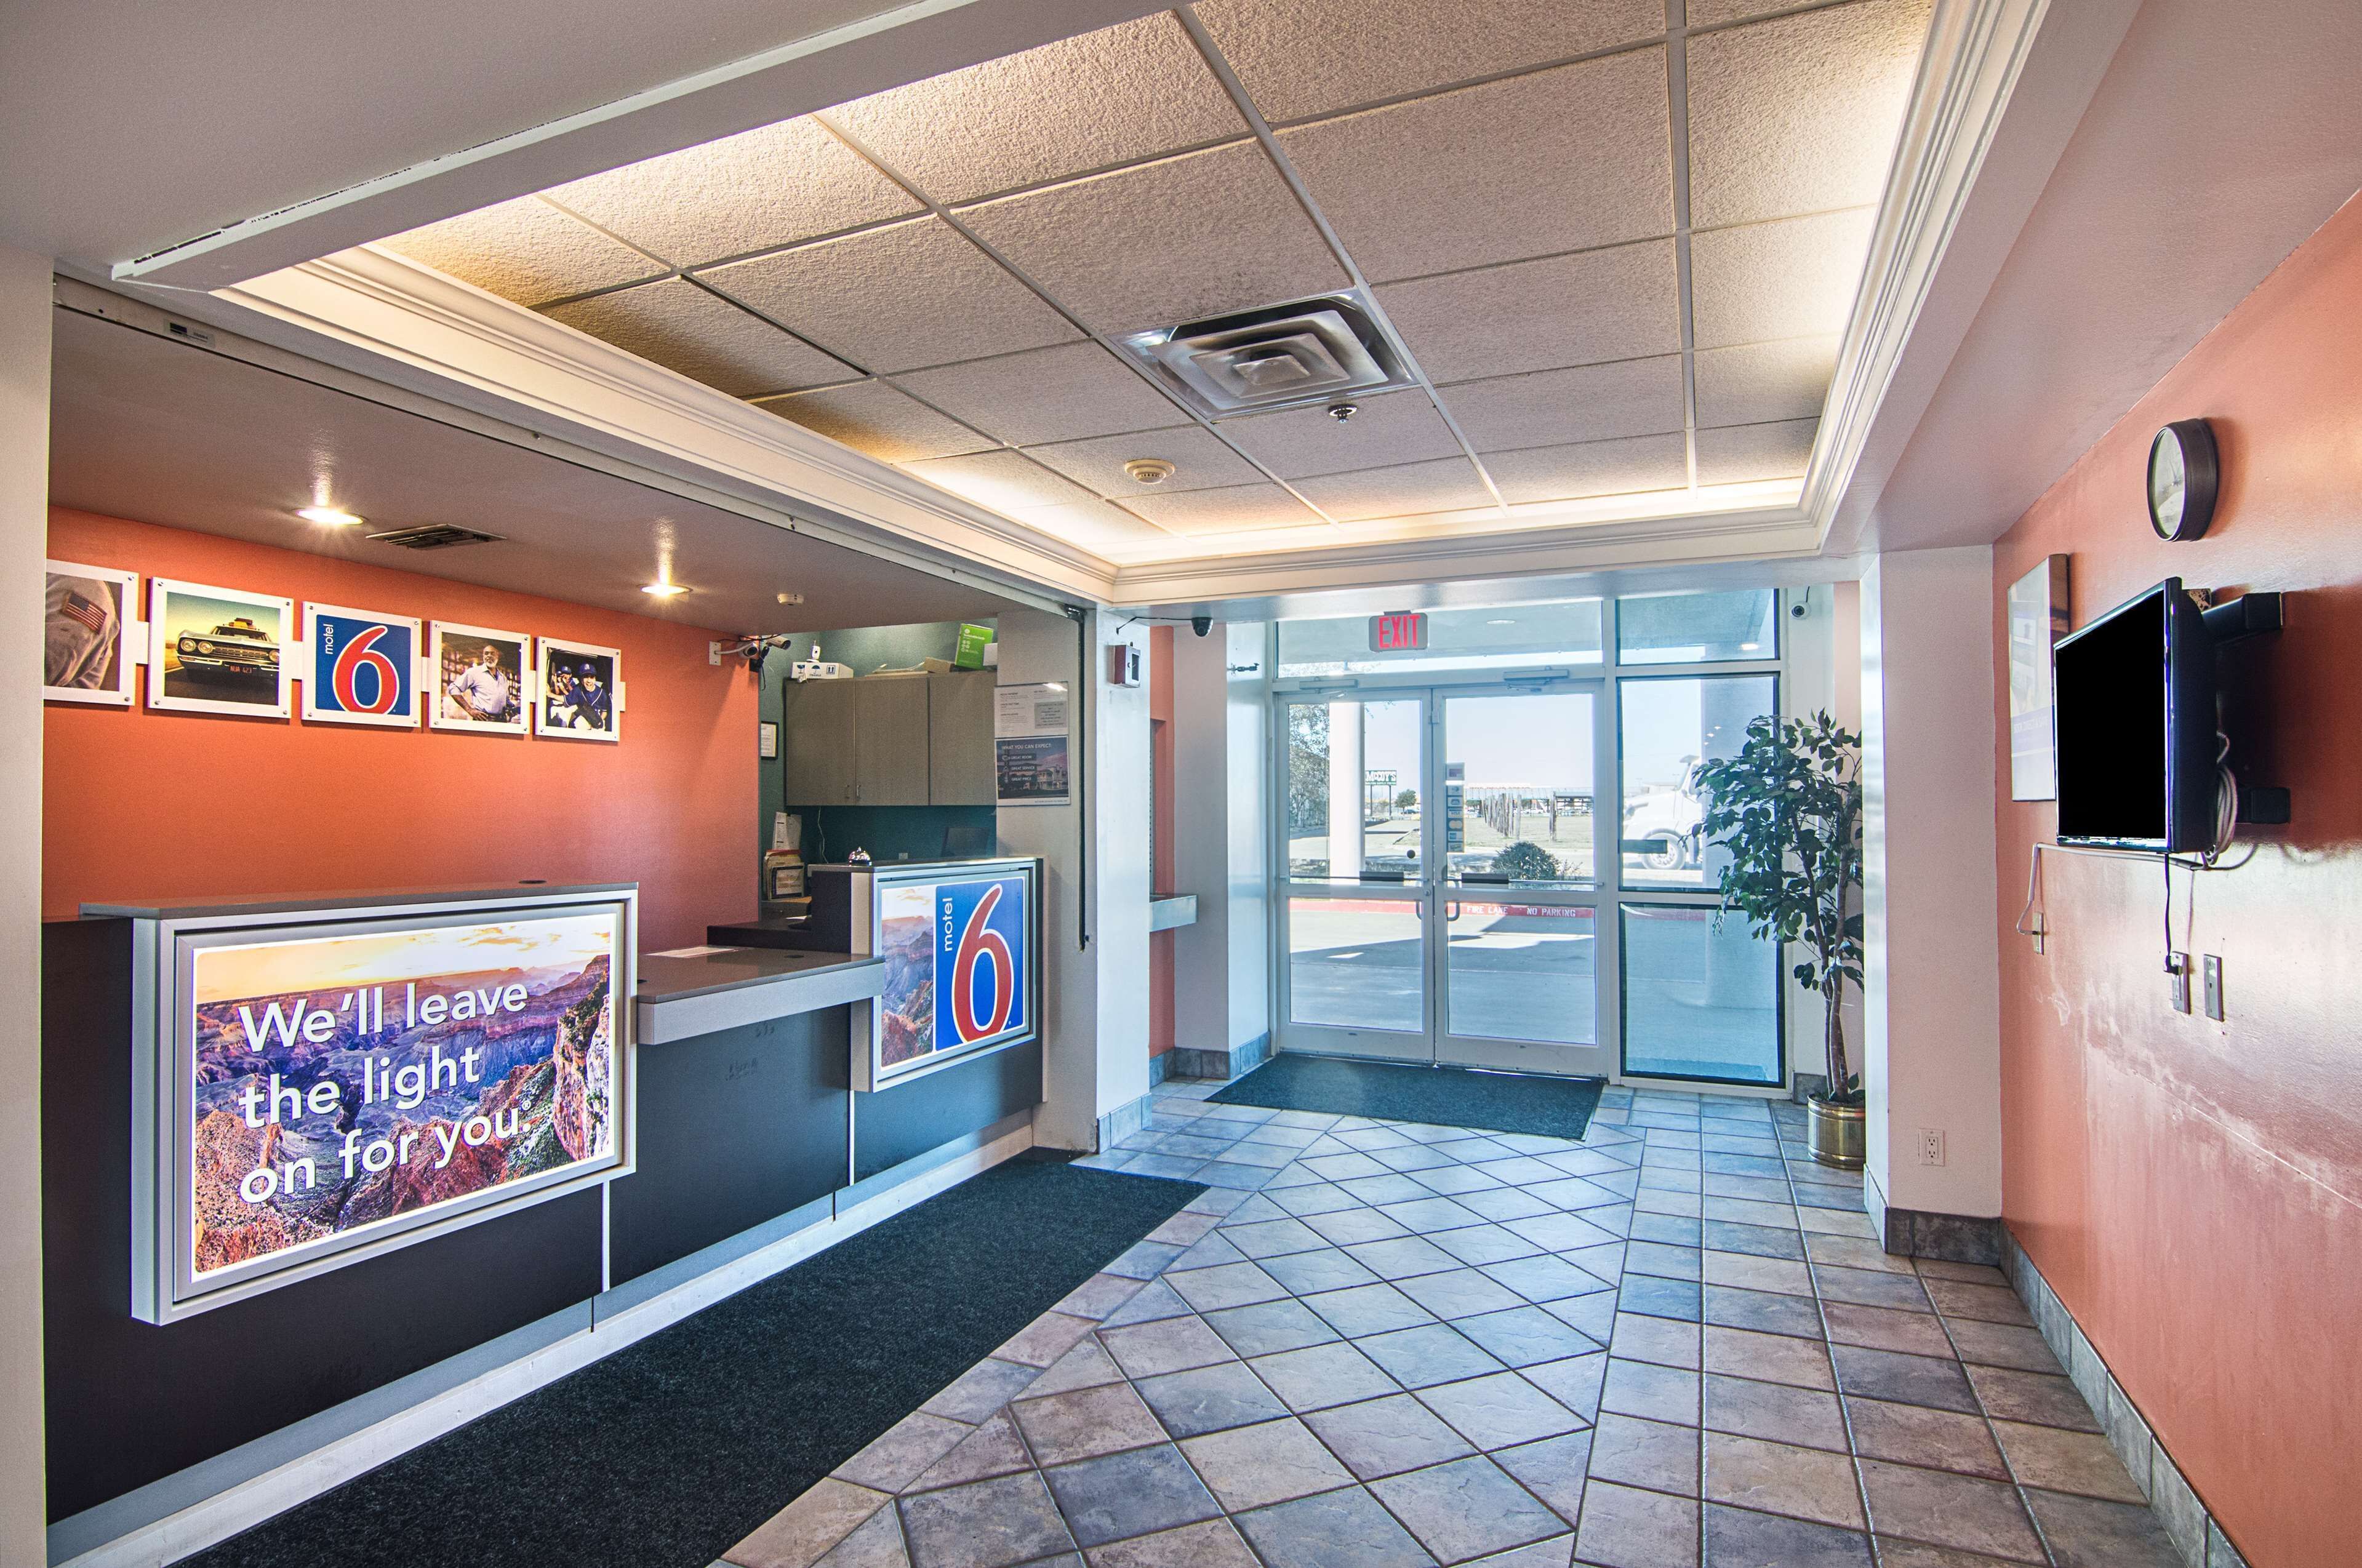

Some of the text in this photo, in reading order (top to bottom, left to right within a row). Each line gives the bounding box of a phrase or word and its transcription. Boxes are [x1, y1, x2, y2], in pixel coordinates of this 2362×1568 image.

[1379, 614, 1421, 649] EXIT
[323, 623, 399, 715] motel 6
[1467, 906, 1508, 915] FIRE LANE
[1526, 907, 1576, 918] NO PARKING
[942, 882, 1014, 1045] motel 6
[238, 982, 529, 1053] We'll leave
[238, 1045, 480, 1129] the light
[239, 1156, 316, 1204] on
[338, 1128, 419, 1180] for
